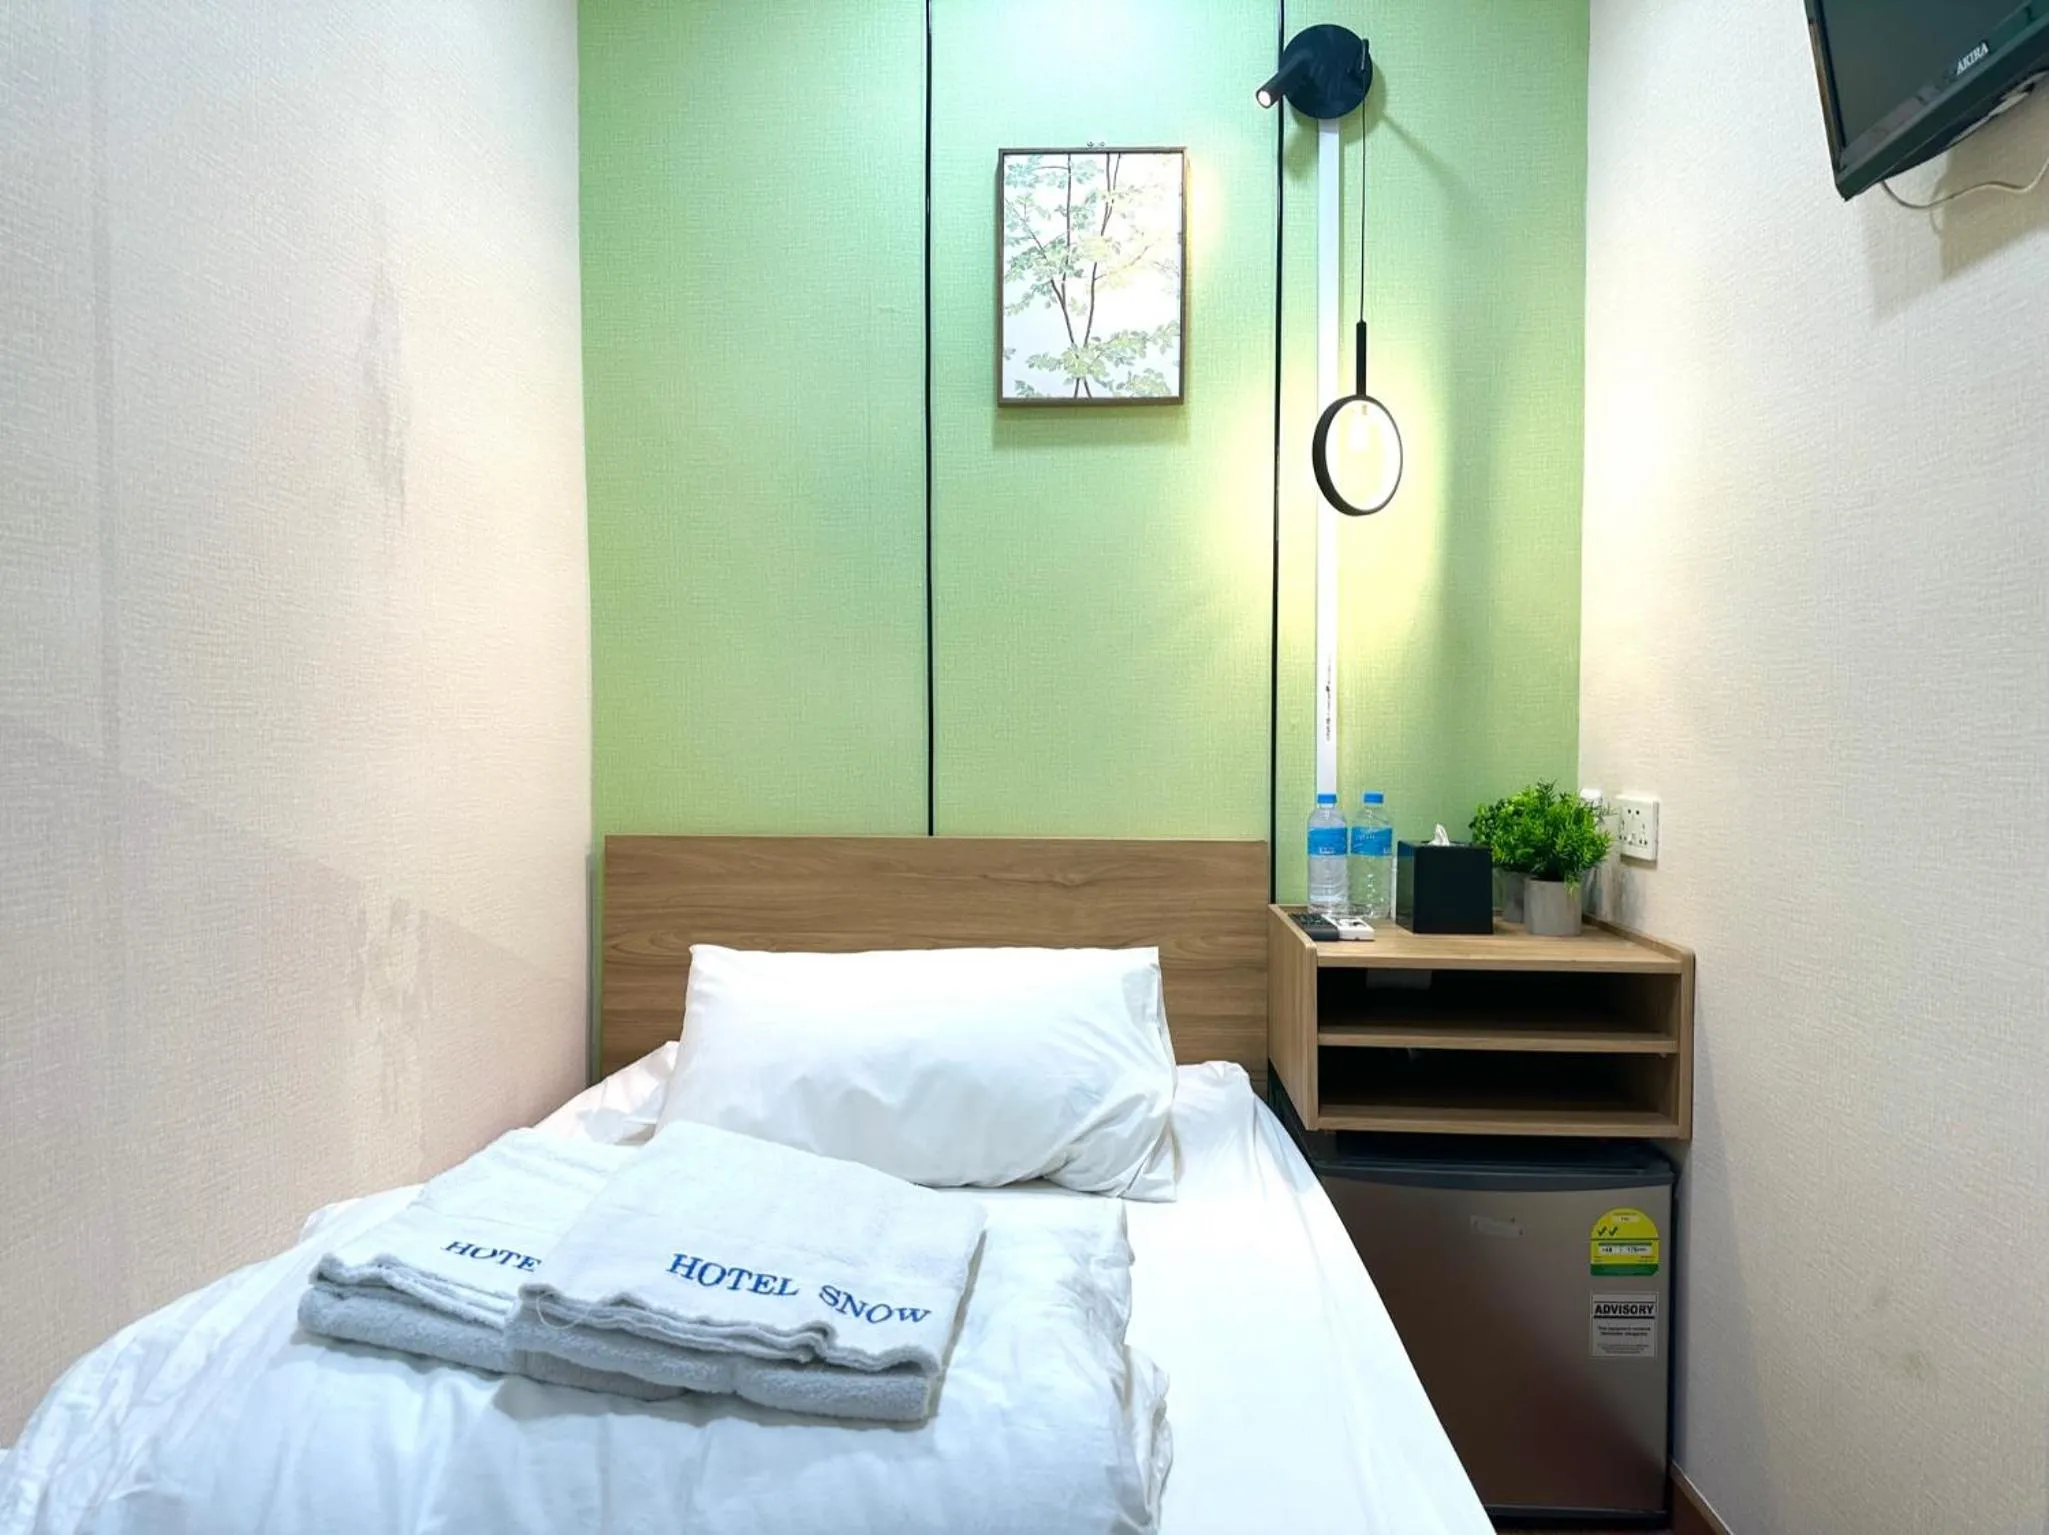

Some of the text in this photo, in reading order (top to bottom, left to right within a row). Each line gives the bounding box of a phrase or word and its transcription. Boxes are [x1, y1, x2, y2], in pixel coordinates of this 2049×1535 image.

[1956, 42, 1989, 75] AKIRA
[442, 1241, 542, 1272] HOTE
[666, 1253, 931, 1324] HOTEL SNOW
[1595, 1303, 1654, 1315] ADVISORY
